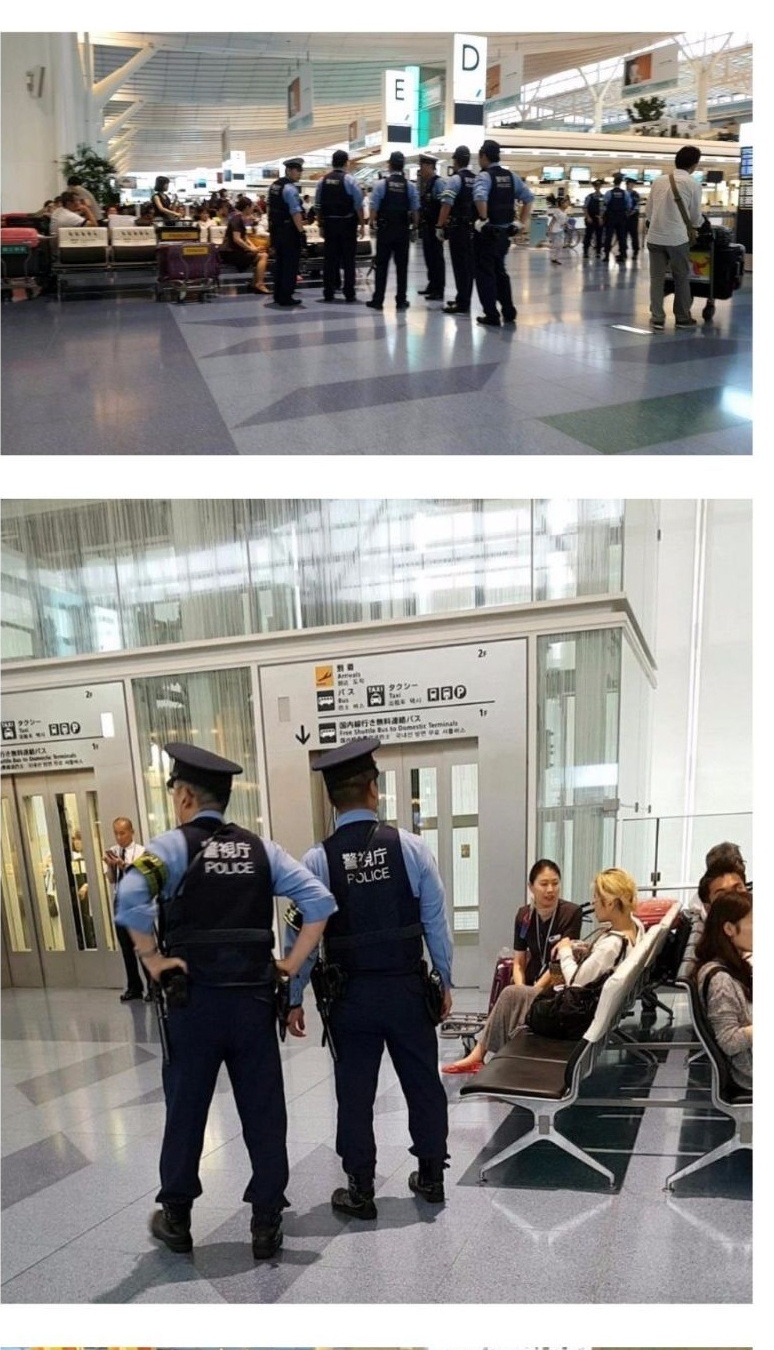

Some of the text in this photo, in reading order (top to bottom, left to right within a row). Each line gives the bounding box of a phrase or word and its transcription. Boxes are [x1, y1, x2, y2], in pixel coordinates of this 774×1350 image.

[462, 44, 480, 71] D
[396, 79, 405, 101] E
[337, 672, 361, 680] Arrivals
[388, 683, 418, 692] タクシー
[354, 727, 376, 735] Shuttle
[390, 725, 397, 733] to
[398, 723, 426, 732] Domestic
[428, 720, 458, 729] Terminals
[201, 841, 251, 859] 警視庁
[204, 861, 255, 874] POLICE
[347, 866, 392, 884] POLICE
